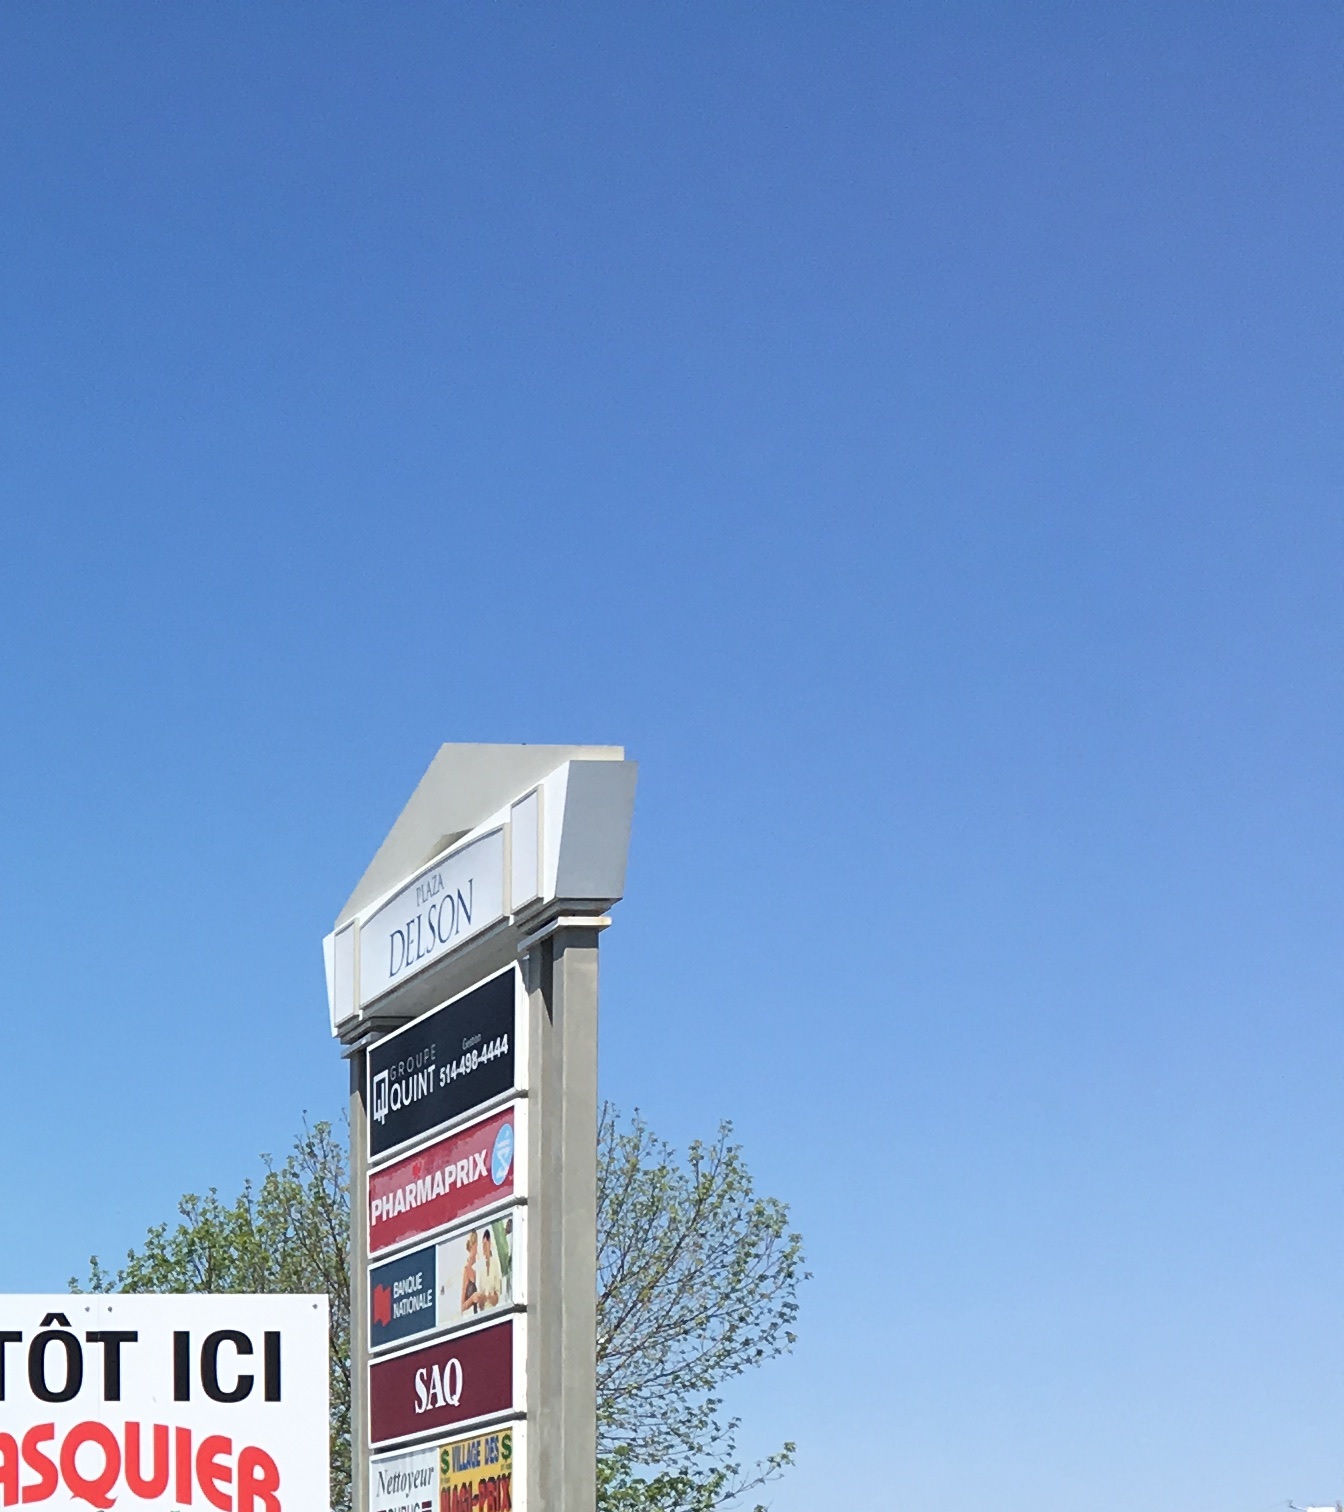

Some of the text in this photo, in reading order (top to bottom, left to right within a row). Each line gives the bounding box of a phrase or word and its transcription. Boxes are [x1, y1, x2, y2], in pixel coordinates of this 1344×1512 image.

[415, 872, 445, 907] PLAZA
[388, 878, 474, 979] DELSON
[390, 1043, 436, 1081] GROUPE
[439, 1033, 509, 1088] 514-498-4444
[390, 1064, 436, 1111] QUINT
[371, 1148, 488, 1227] PHARMAPRIX
[393, 1272, 423, 1299] BANQUE
[393, 1289, 433, 1320] NATIONALE
[172, 1328, 282, 1403] ICI
[415, 1358, 463, 1413] SAQ
[376, 1466, 434, 1499] Nettoyeur
